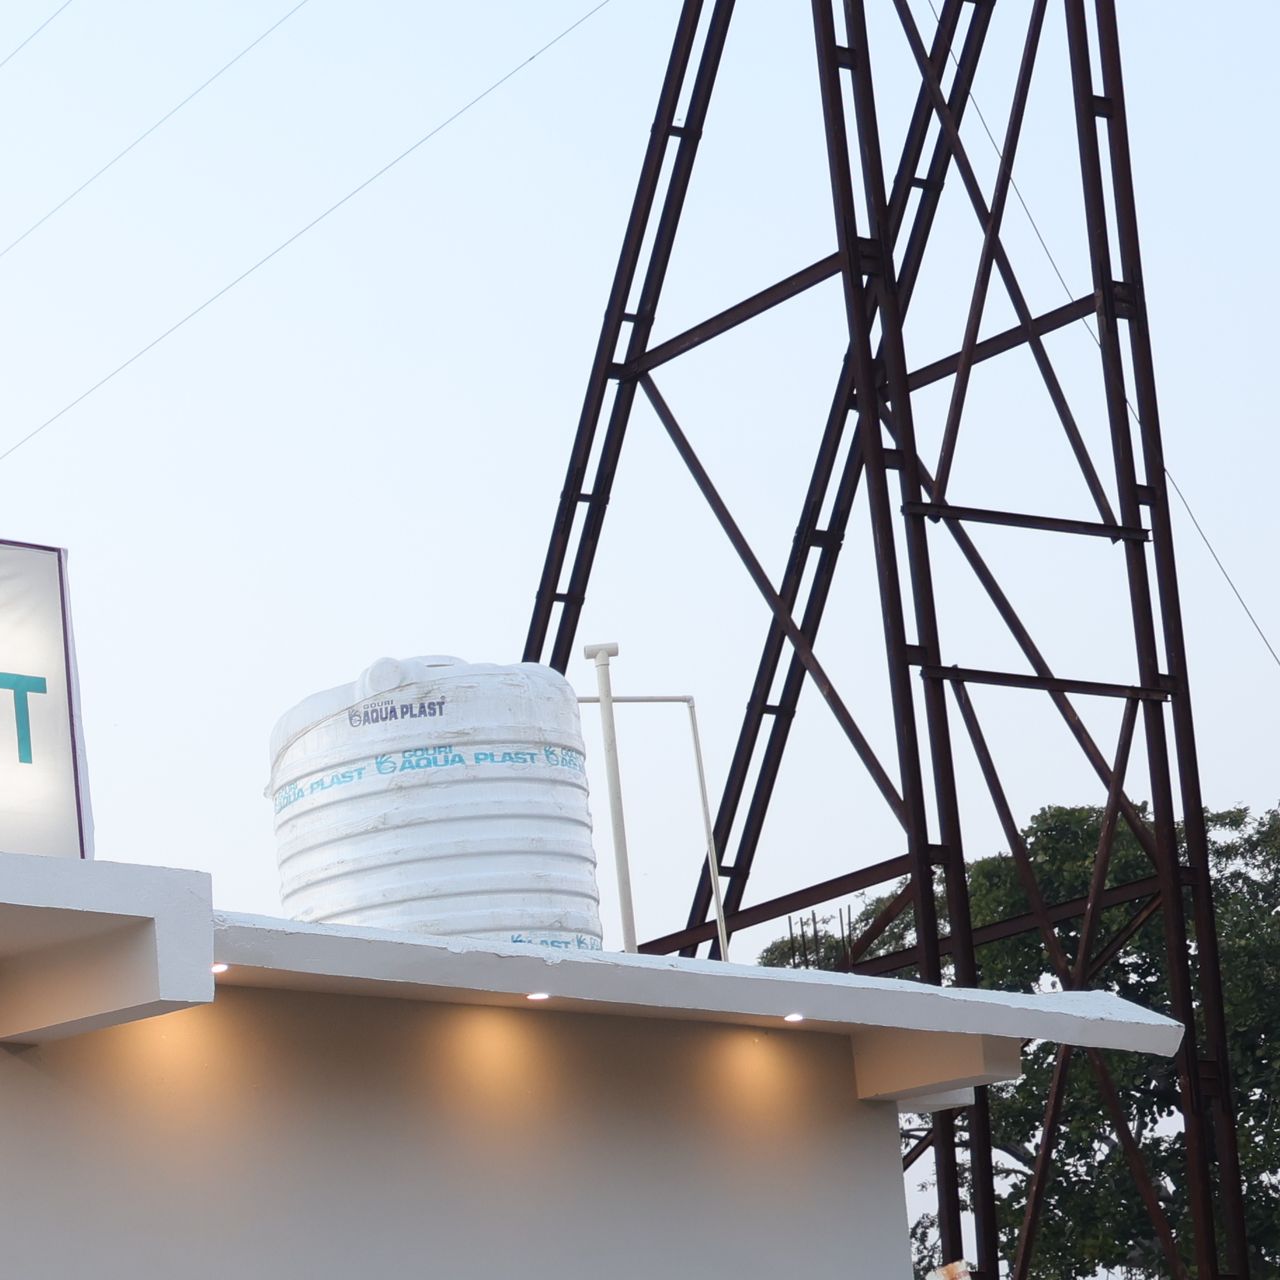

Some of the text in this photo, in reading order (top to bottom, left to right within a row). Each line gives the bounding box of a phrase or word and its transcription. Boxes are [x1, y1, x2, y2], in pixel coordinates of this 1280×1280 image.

[362, 701, 445, 726] AQUA PLAST
[400, 752, 538, 772] AQUA PLAST
[402, 745, 453, 759] GOURI
[310, 767, 366, 794] PLAST
